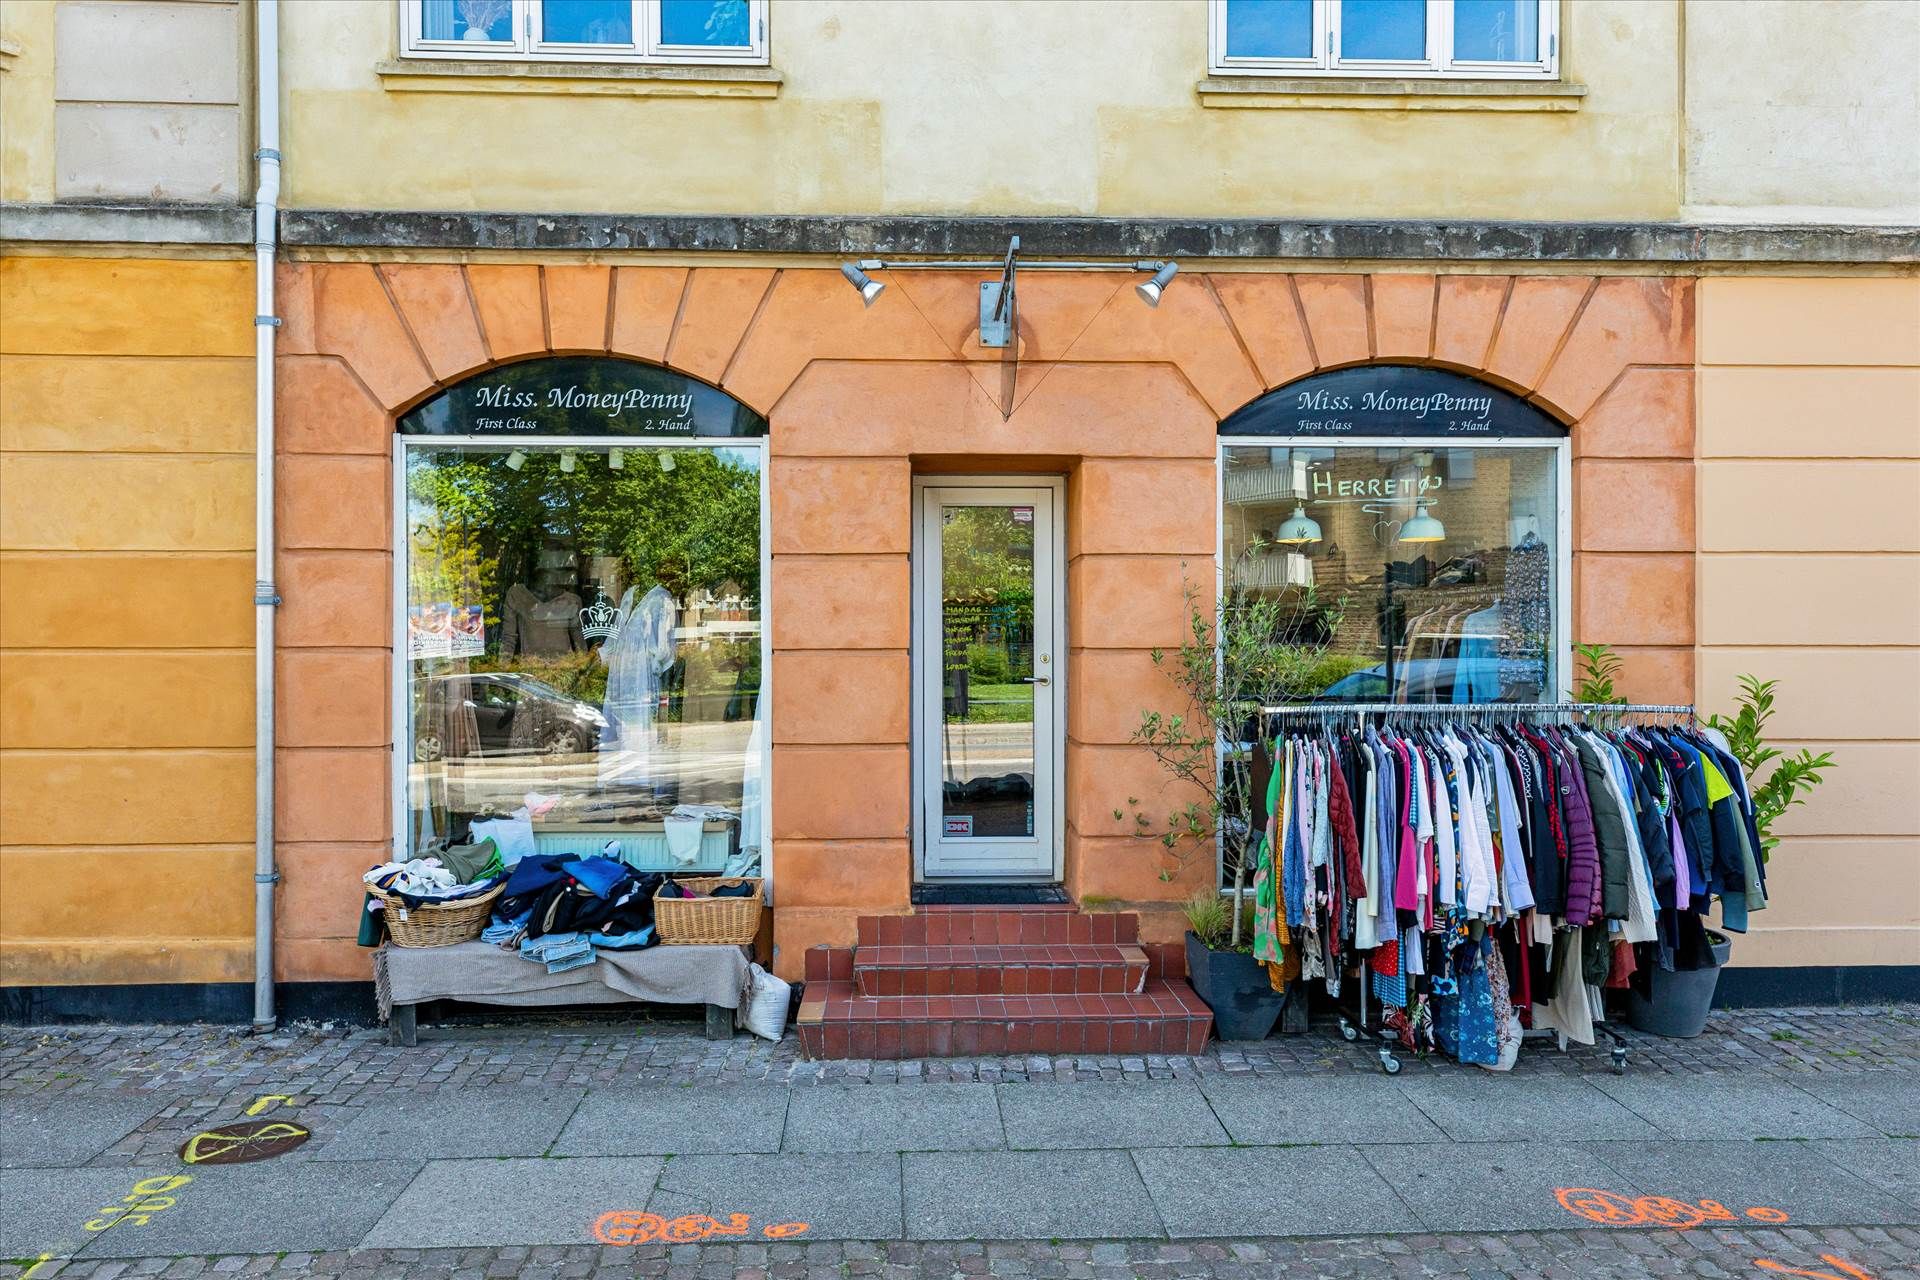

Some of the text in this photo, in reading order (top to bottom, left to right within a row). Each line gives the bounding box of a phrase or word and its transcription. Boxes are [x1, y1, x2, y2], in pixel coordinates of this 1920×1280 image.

[475, 384, 693, 418] Miss. MoneyPenny
[1297, 389, 1492, 420] Miss. MoneyPenny
[475, 416, 537, 431] First Class
[644, 418, 693, 430] 2. Hand
[1297, 418, 1353, 432] First Class
[1448, 419, 1491, 431] 2. Hand
[945, 606, 982, 614] MANDAG
